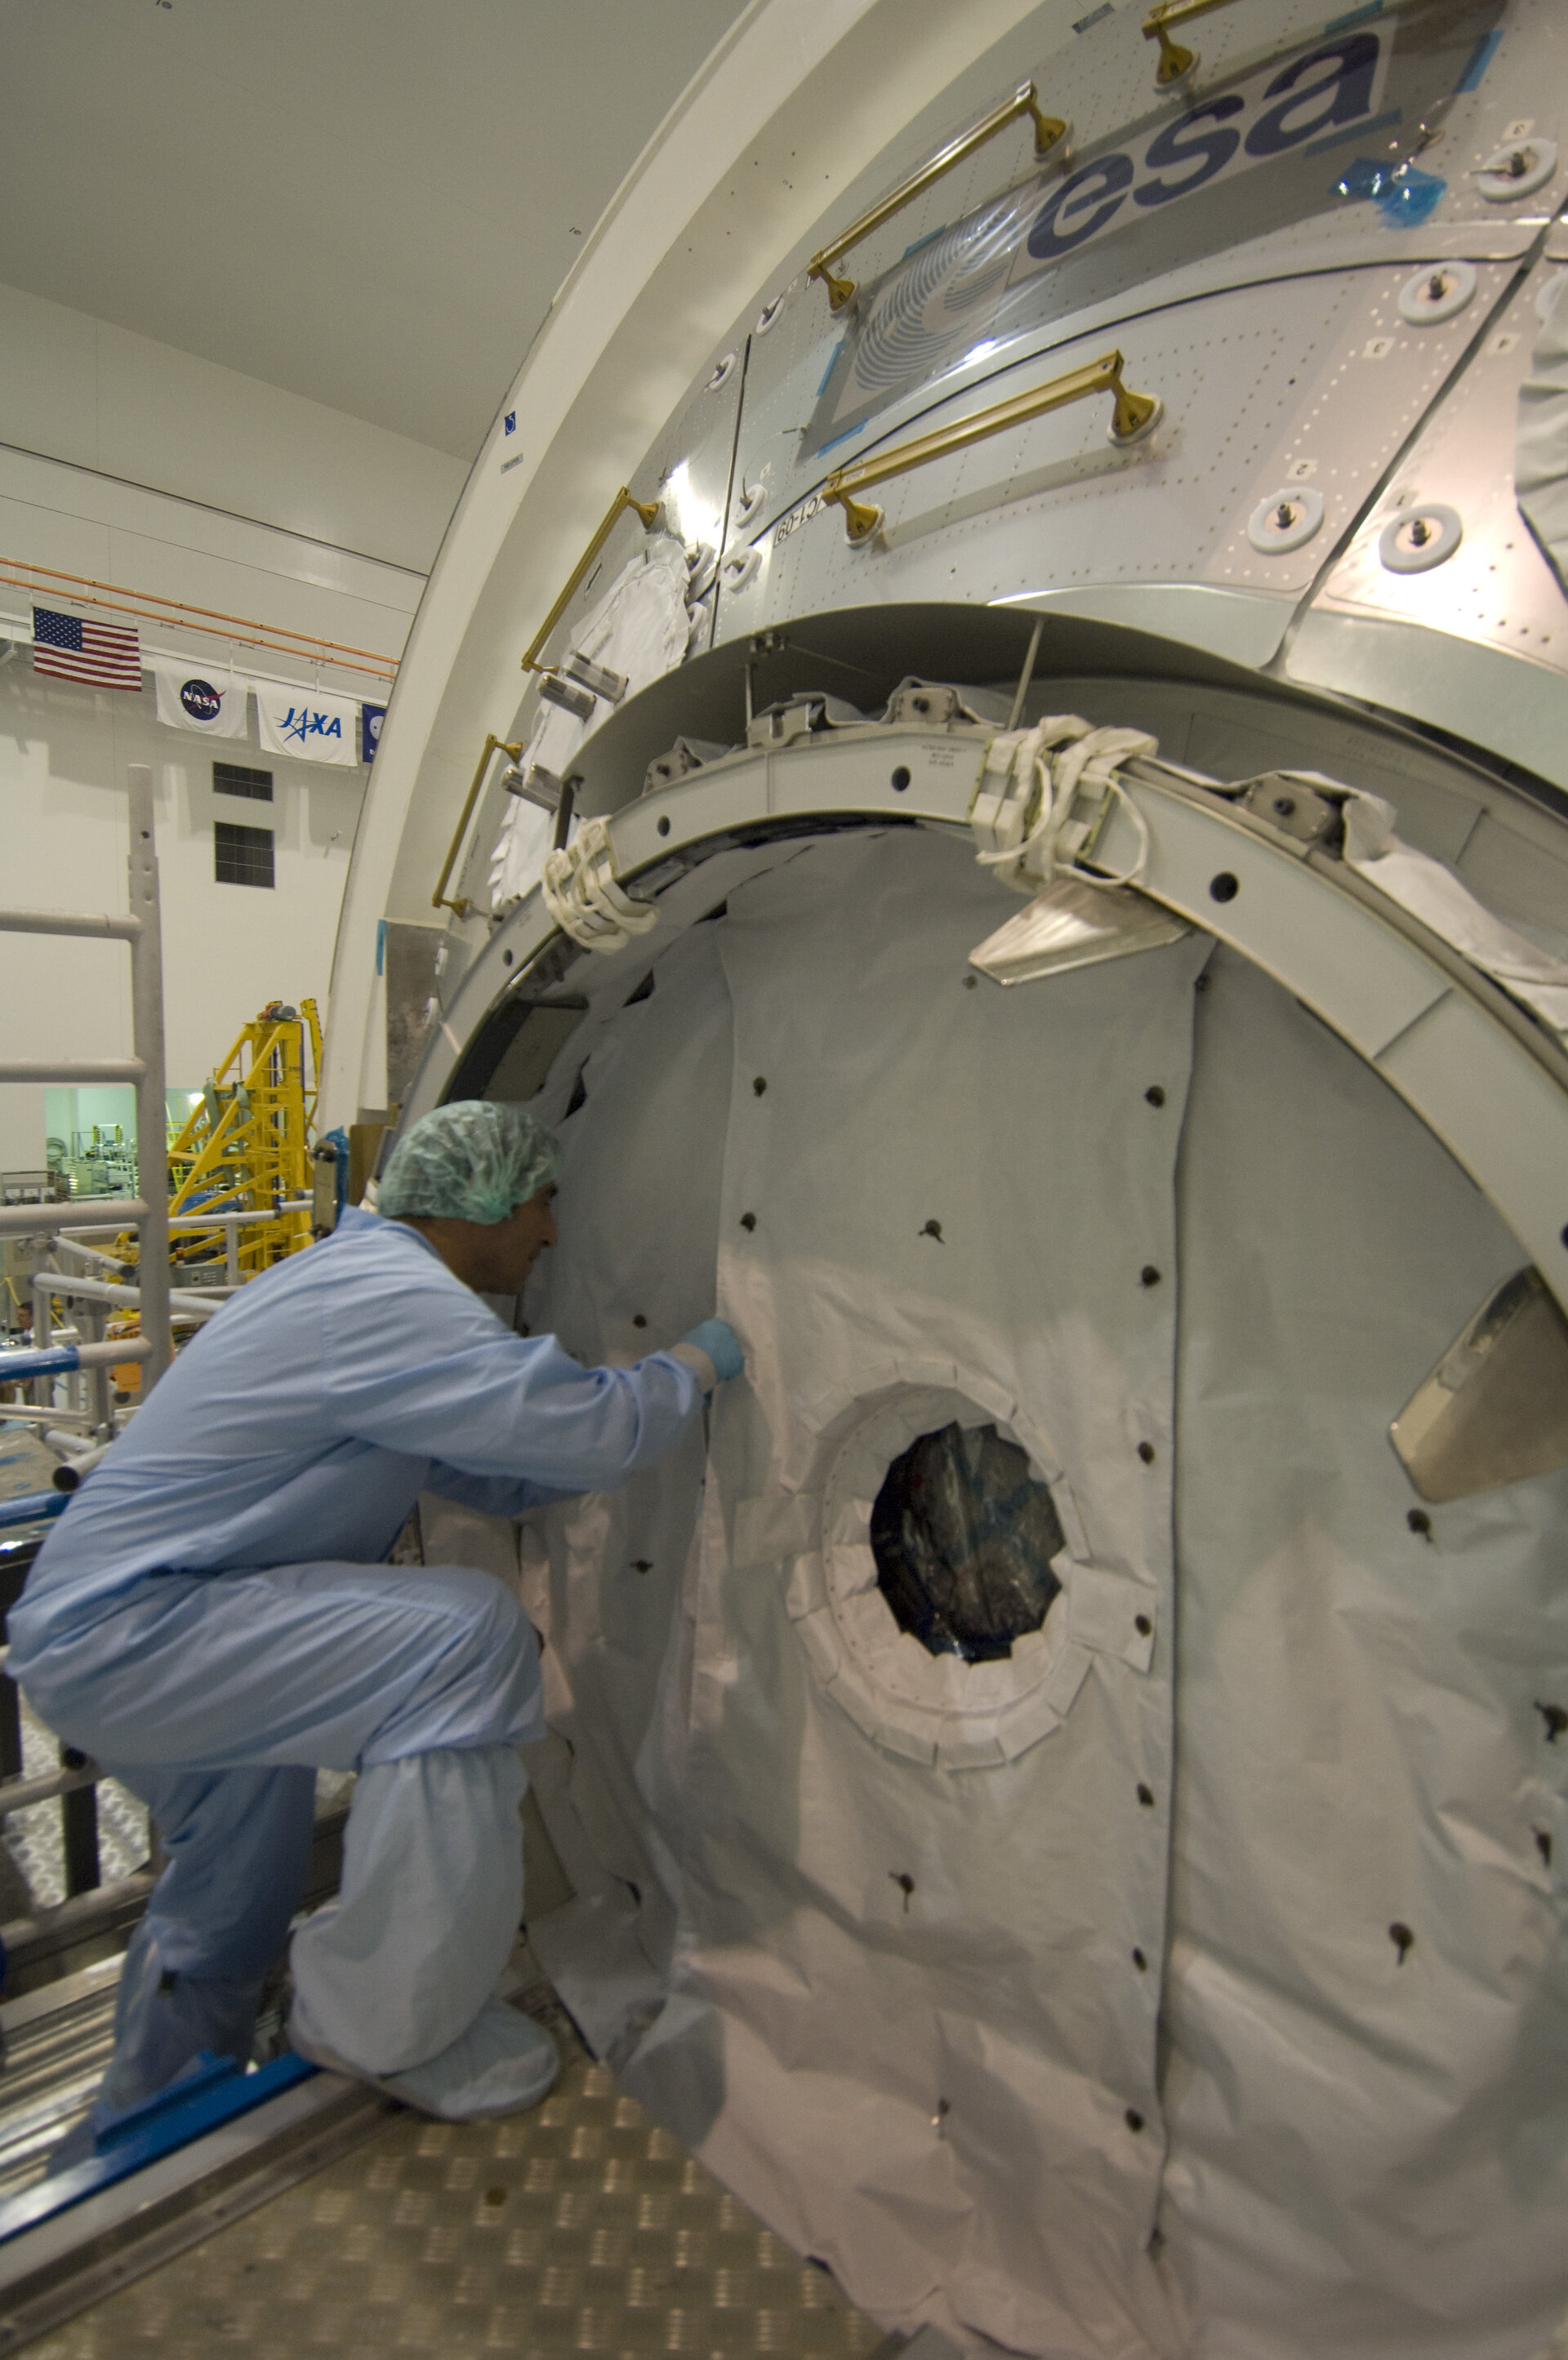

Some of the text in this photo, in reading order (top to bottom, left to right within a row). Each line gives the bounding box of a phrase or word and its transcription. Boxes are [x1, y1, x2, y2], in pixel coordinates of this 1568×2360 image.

[1027, 32, 1380, 260] esa
[183, 691, 219, 710] NASA
[274, 707, 341, 743] JAXA
